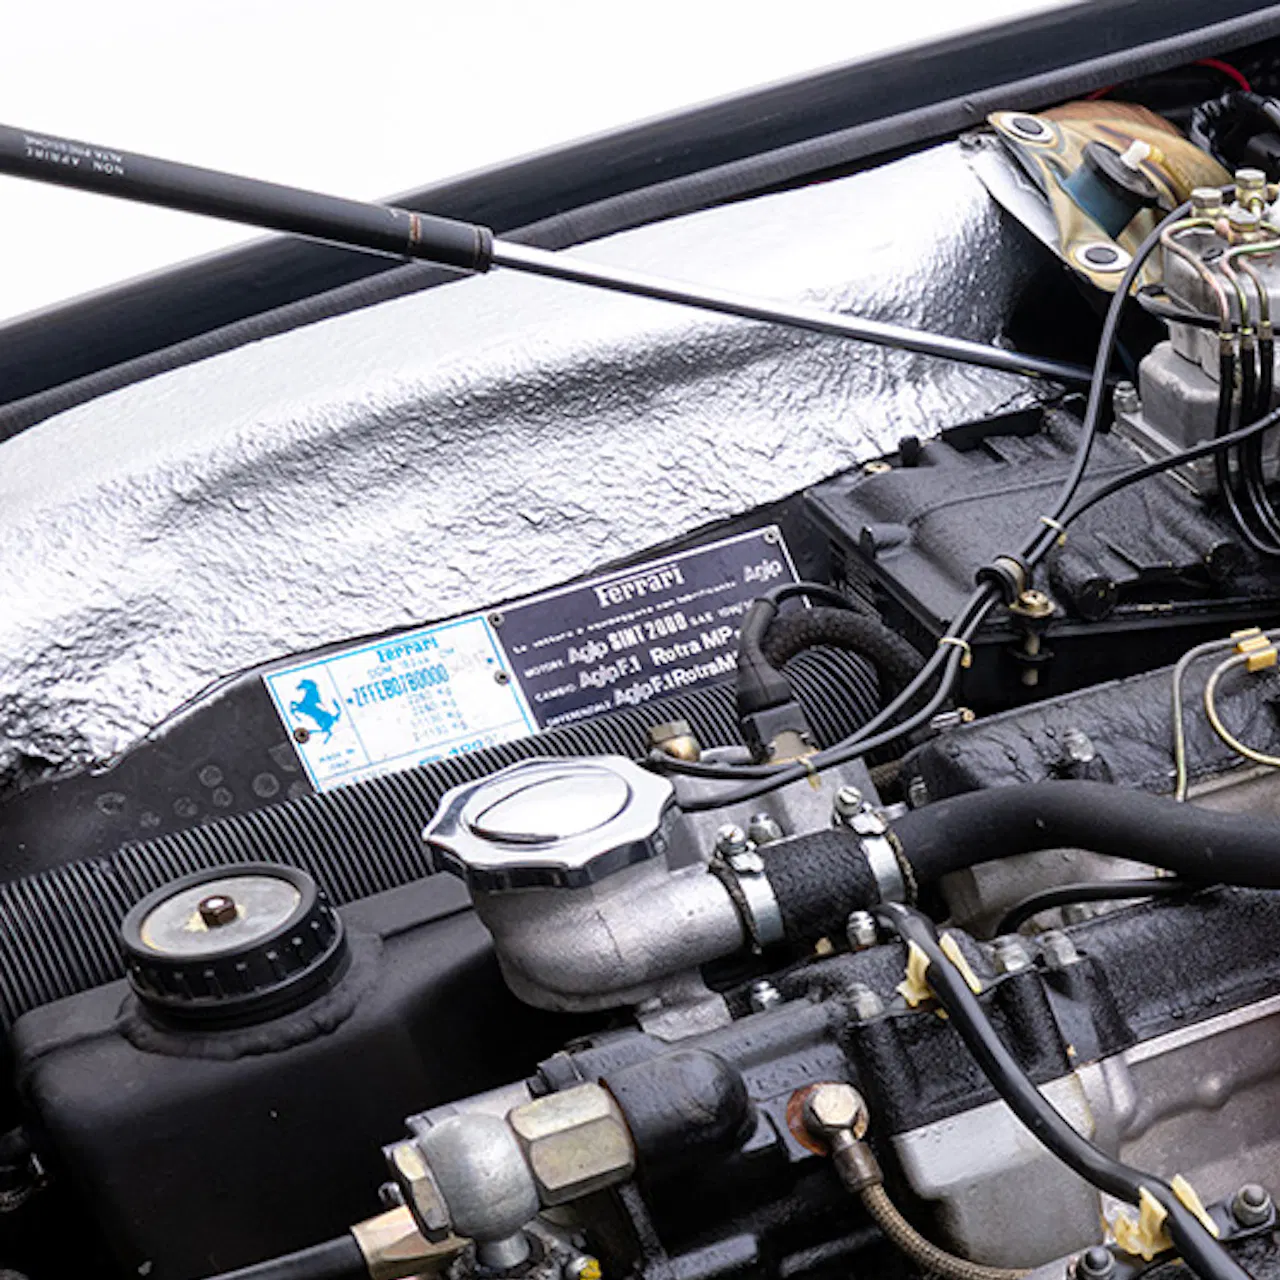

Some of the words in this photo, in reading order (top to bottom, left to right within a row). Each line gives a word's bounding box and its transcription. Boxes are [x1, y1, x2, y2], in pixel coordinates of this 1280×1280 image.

[591, 563, 686, 609] Ferrari
[742, 558, 783, 583] Agip
[376, 635, 440, 663] Ferrari
[566, 640, 609, 666] Agip
[607, 625, 645, 653] SINT
[578, 665, 621, 690] Agip
[650, 639, 702, 667] Rotra
[612, 682, 651, 708] Agip
